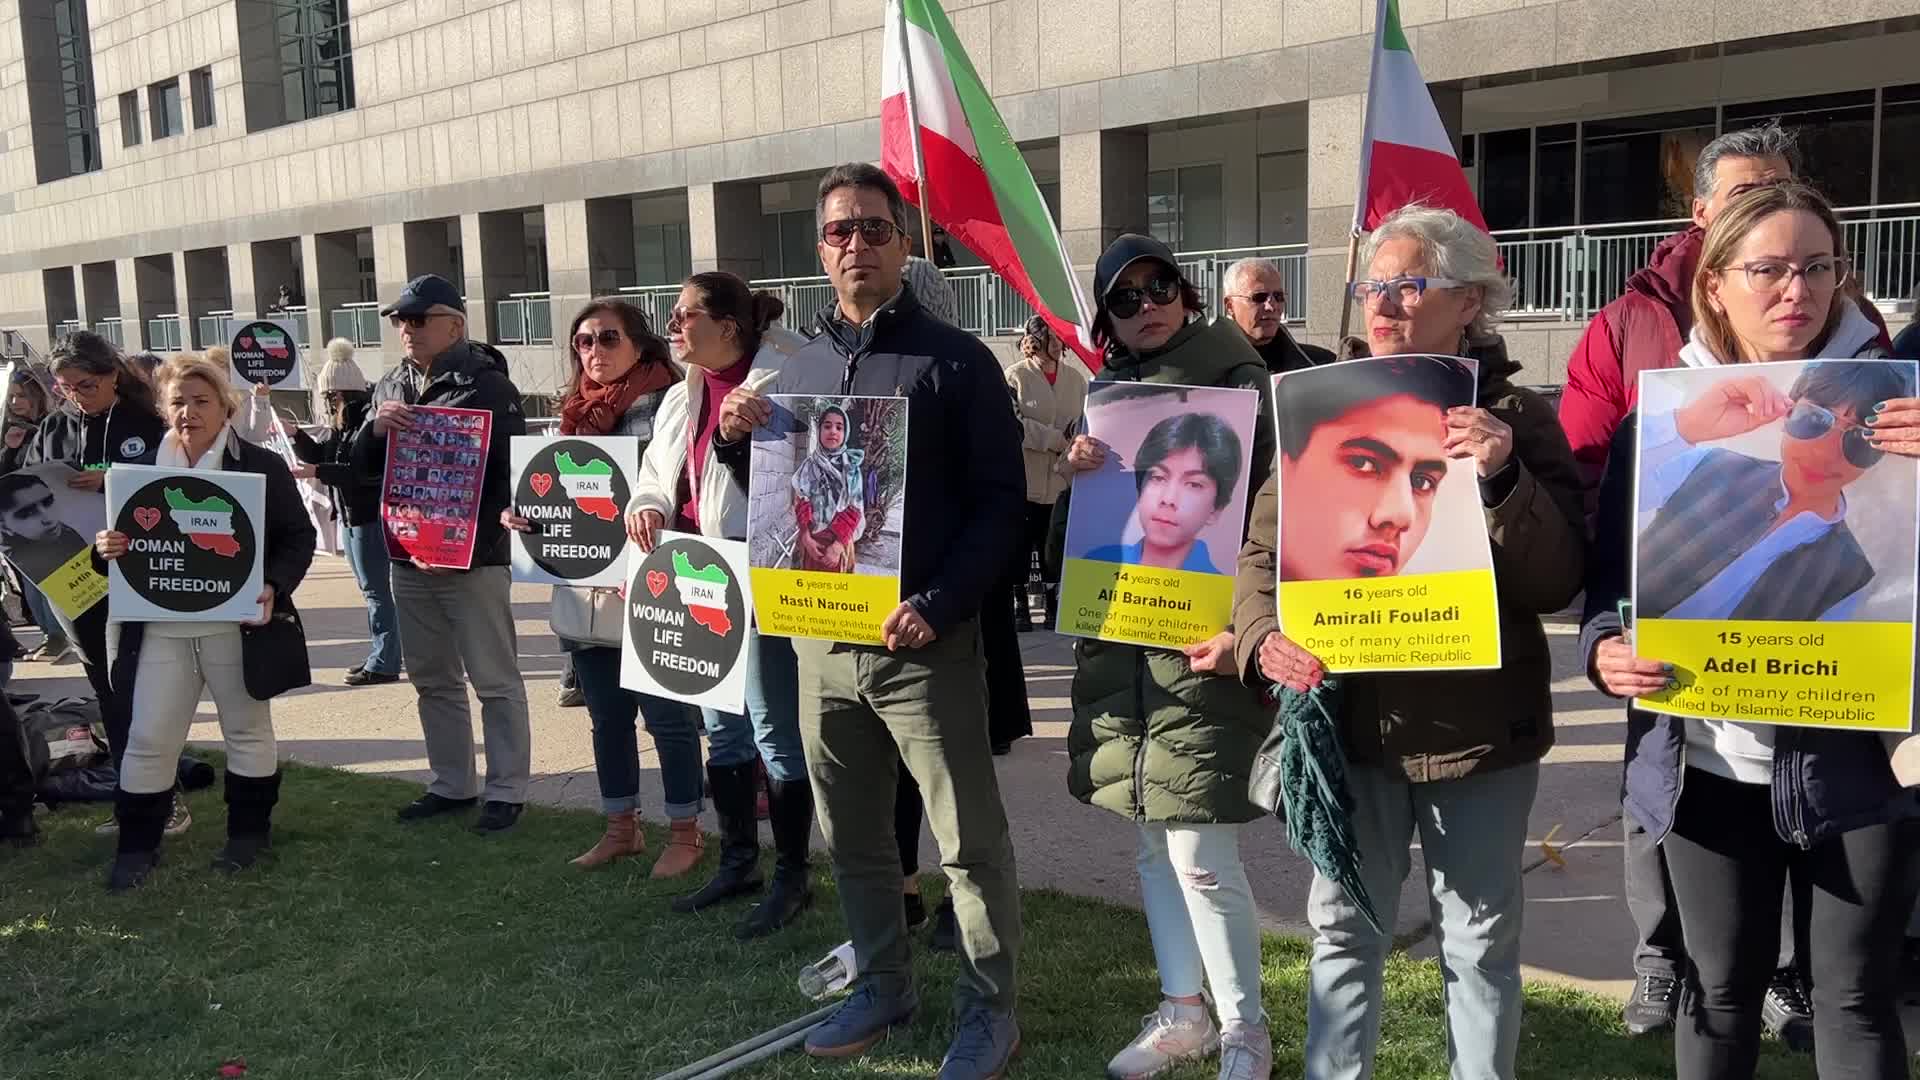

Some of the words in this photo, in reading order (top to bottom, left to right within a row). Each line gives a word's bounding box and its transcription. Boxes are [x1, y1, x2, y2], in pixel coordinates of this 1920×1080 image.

[577, 482, 599, 490] IRAN
[519, 505, 572, 519] WOMAN
[191, 517, 217, 527] IRAN
[543, 524, 572, 537] LIFE
[542, 544, 611, 559] FREEDOM
[149, 558, 185, 571] LIFE
[149, 577, 230, 593] FREEDOM
[796, 579, 804, 587] 6
[806, 581, 832, 590] years
[834, 582, 848, 591] old
[1113, 571, 1128, 581] 14
[1131, 574, 1160, 586] years
[1163, 578, 1180, 588] old
[691, 586, 714, 599] IRAN
[1097, 588, 1118, 602] Ali
[1123, 591, 1191, 611] Barahoui
[1344, 589, 1363, 600] 16
[1366, 587, 1404, 601] years
[1407, 585, 1428, 598] old
[780, 595, 813, 608] Hasti
[818, 598, 869, 612] Narouei
[632, 603, 685, 627] WOMAN
[772, 611, 793, 621] One
[796, 614, 806, 622] of
[809, 617, 836, 627] many
[840, 620, 881, 631] children
[1078, 606, 1102, 618] One
[1105, 611, 1117, 620] of
[1121, 614, 1154, 627] many
[1158, 617, 1208, 633] children
[1313, 610, 1382, 626] Amirali
[1389, 606, 1460, 624] Fouladi
[653, 628, 683, 647] LIFE
[799, 625, 809, 636] by
[1075, 621, 1101, 633] killed
[1104, 624, 1116, 636] by
[1119, 626, 1156, 640] Islamic
[1305, 637, 1334, 649] One
[1340, 635, 1354, 648] of
[1359, 635, 1401, 649] many
[1407, 632, 1471, 646] children
[1717, 632, 1742, 645] 15
[1747, 634, 1794, 648] years
[1799, 633, 1824, 647] old
[652, 650, 720, 678] FREEDOM
[1339, 653, 1355, 666] by
[1359, 651, 1407, 664] Islamic
[1410, 650, 1472, 665] Republic
[1703, 657, 1756, 674] Adel
[1766, 659, 1839, 676] Brichi
[1667, 680, 1704, 694] One
[1712, 684, 1730, 697] of
[1737, 687, 1788, 702] many
[1796, 688, 1876, 703] children
[1665, 694, 1705, 711] killed
[1711, 701, 1730, 715] by
[1736, 703, 1794, 717] Islamic
[1799, 706, 1876, 722] Republic
